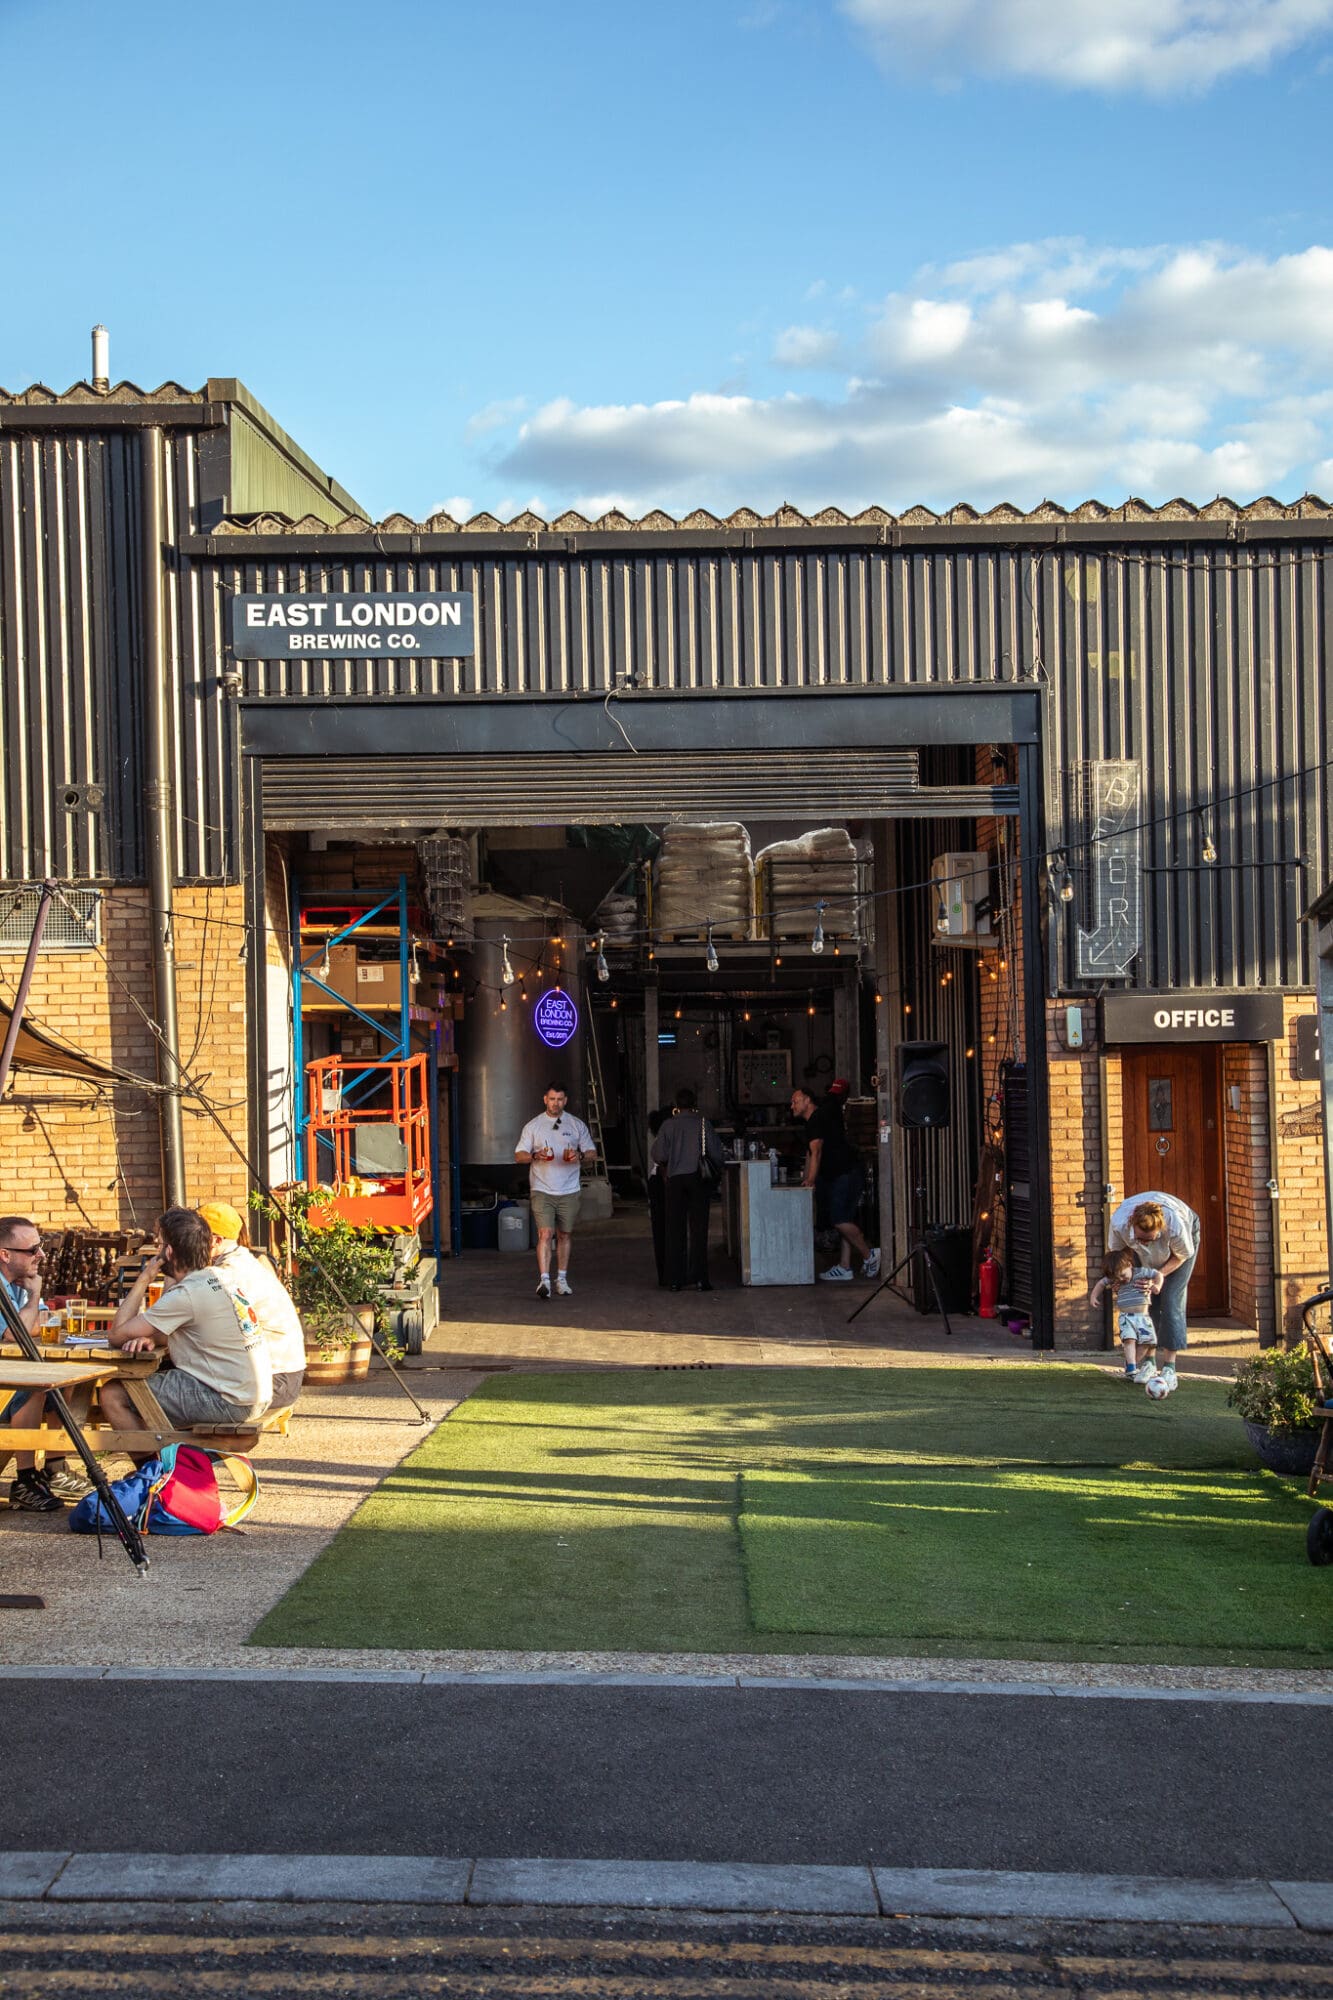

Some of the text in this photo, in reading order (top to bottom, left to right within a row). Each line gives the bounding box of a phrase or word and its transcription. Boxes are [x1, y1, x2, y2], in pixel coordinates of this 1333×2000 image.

[246, 602, 461, 627] EAST LONDON
[289, 633, 421, 650] BREWING CO.
[1091, 776, 1130, 927] BEER
[546, 999, 567, 1009] EAST
[540, 1008, 572, 1019] LONDON
[1153, 1009, 1235, 1028] OFFICE
